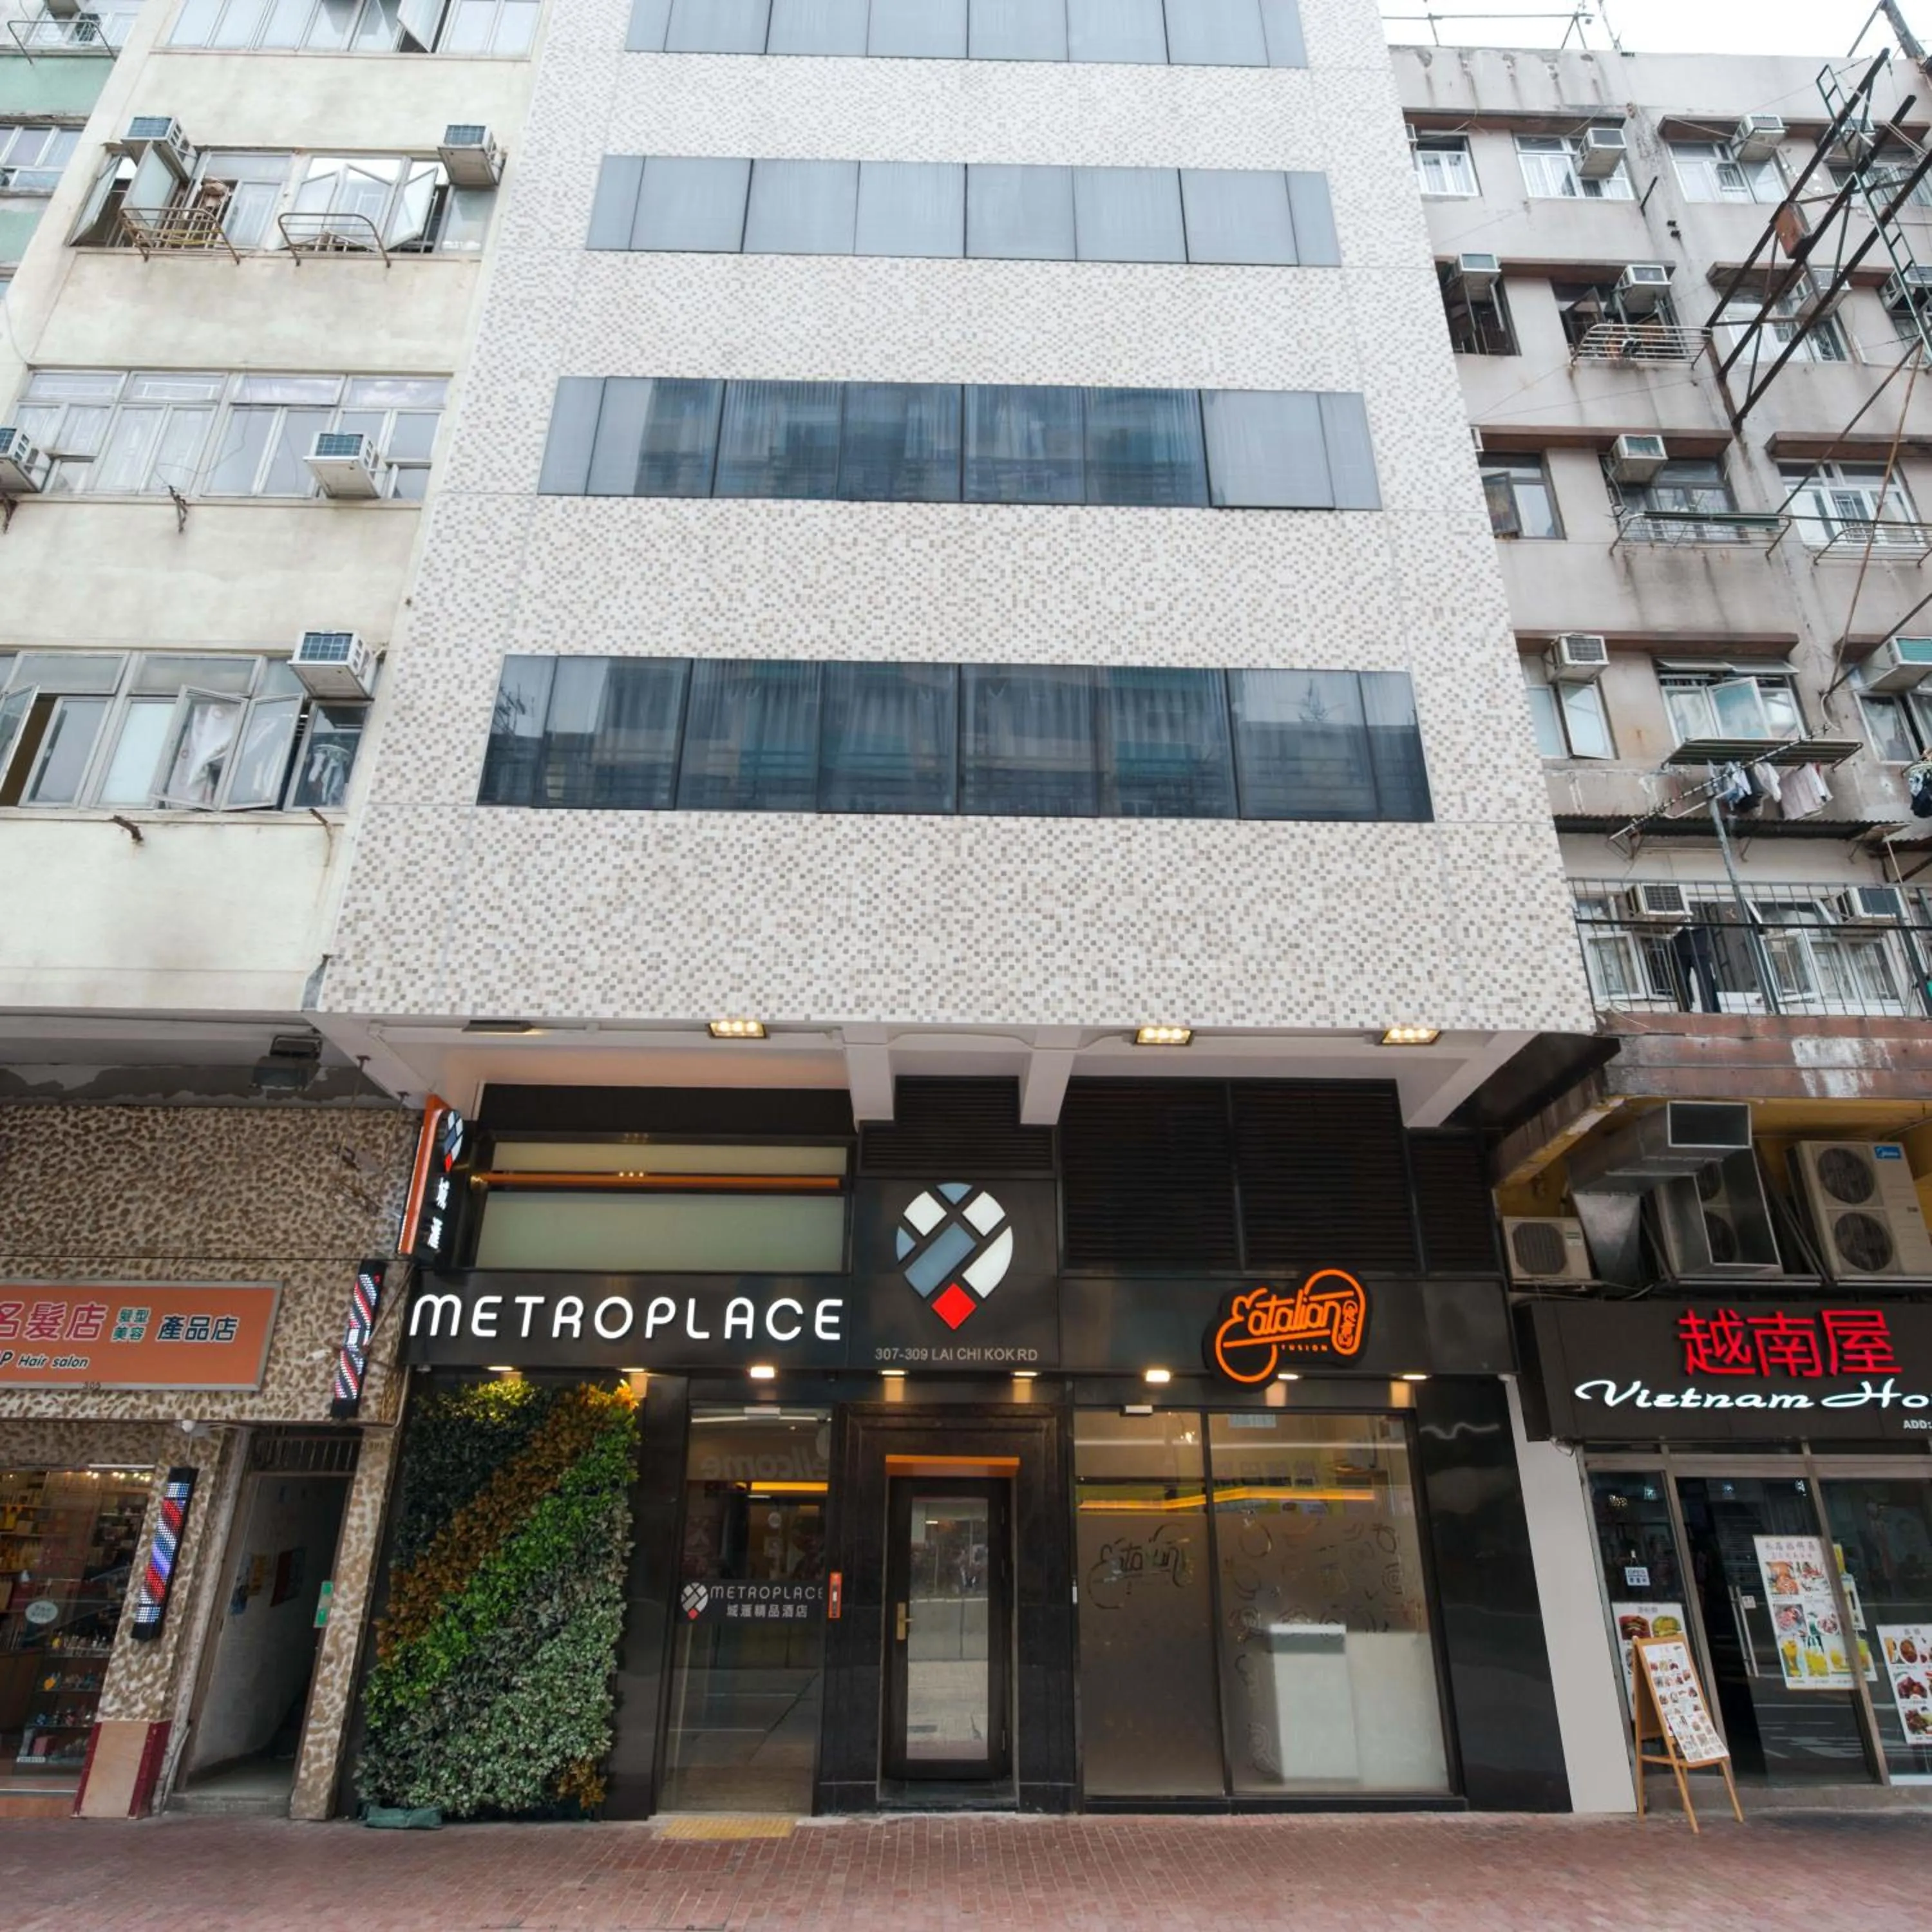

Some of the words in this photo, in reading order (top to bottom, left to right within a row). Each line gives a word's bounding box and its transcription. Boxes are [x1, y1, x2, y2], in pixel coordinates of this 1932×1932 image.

[156, 1314, 238, 1341] 產品店
[409, 1294, 843, 1341] METROPLACE
[875, 1347, 928, 1361] 307-309
[931, 1348, 952, 1360] LAI
[956, 1348, 981, 1360] CHI
[985, 1348, 1016, 1361] KOK
[1017, 1348, 1037, 1361] RD
[1678, 1309, 1902, 1377] 越南屋
[0, 1350, 13, 1365] P
[18, 1354, 48, 1367] Hair
[52, 1356, 90, 1368] salon
[1575, 1379, 1814, 1408] Vietnam
[1822, 1378, 1932, 1408] Ho
[710, 1586, 823, 1600] METROPLACE
